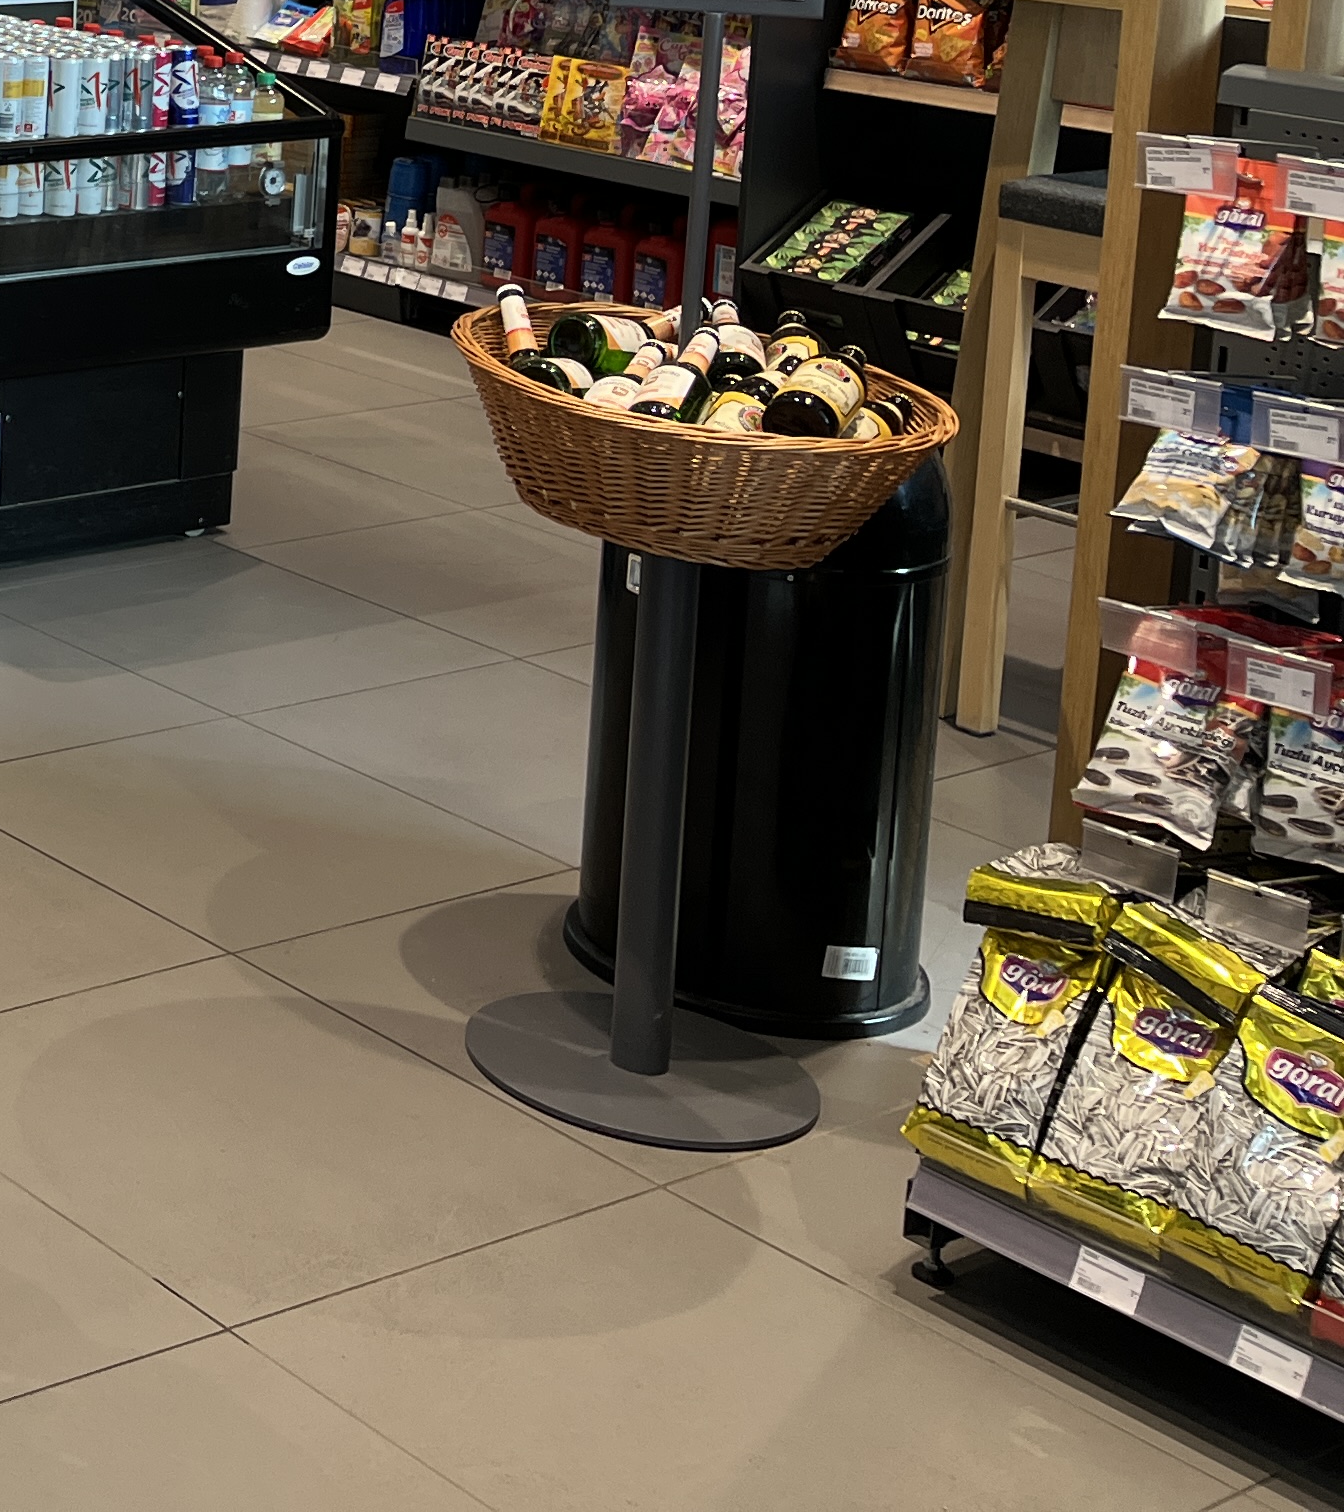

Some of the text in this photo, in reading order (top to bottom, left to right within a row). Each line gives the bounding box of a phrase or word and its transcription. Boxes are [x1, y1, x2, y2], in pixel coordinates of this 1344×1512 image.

[916, 4, 973, 27] Doritos
[1218, 209, 1264, 228] göral
[1138, 1014, 1212, 1057] göral
[1270, 1053, 1343, 1114] göral
